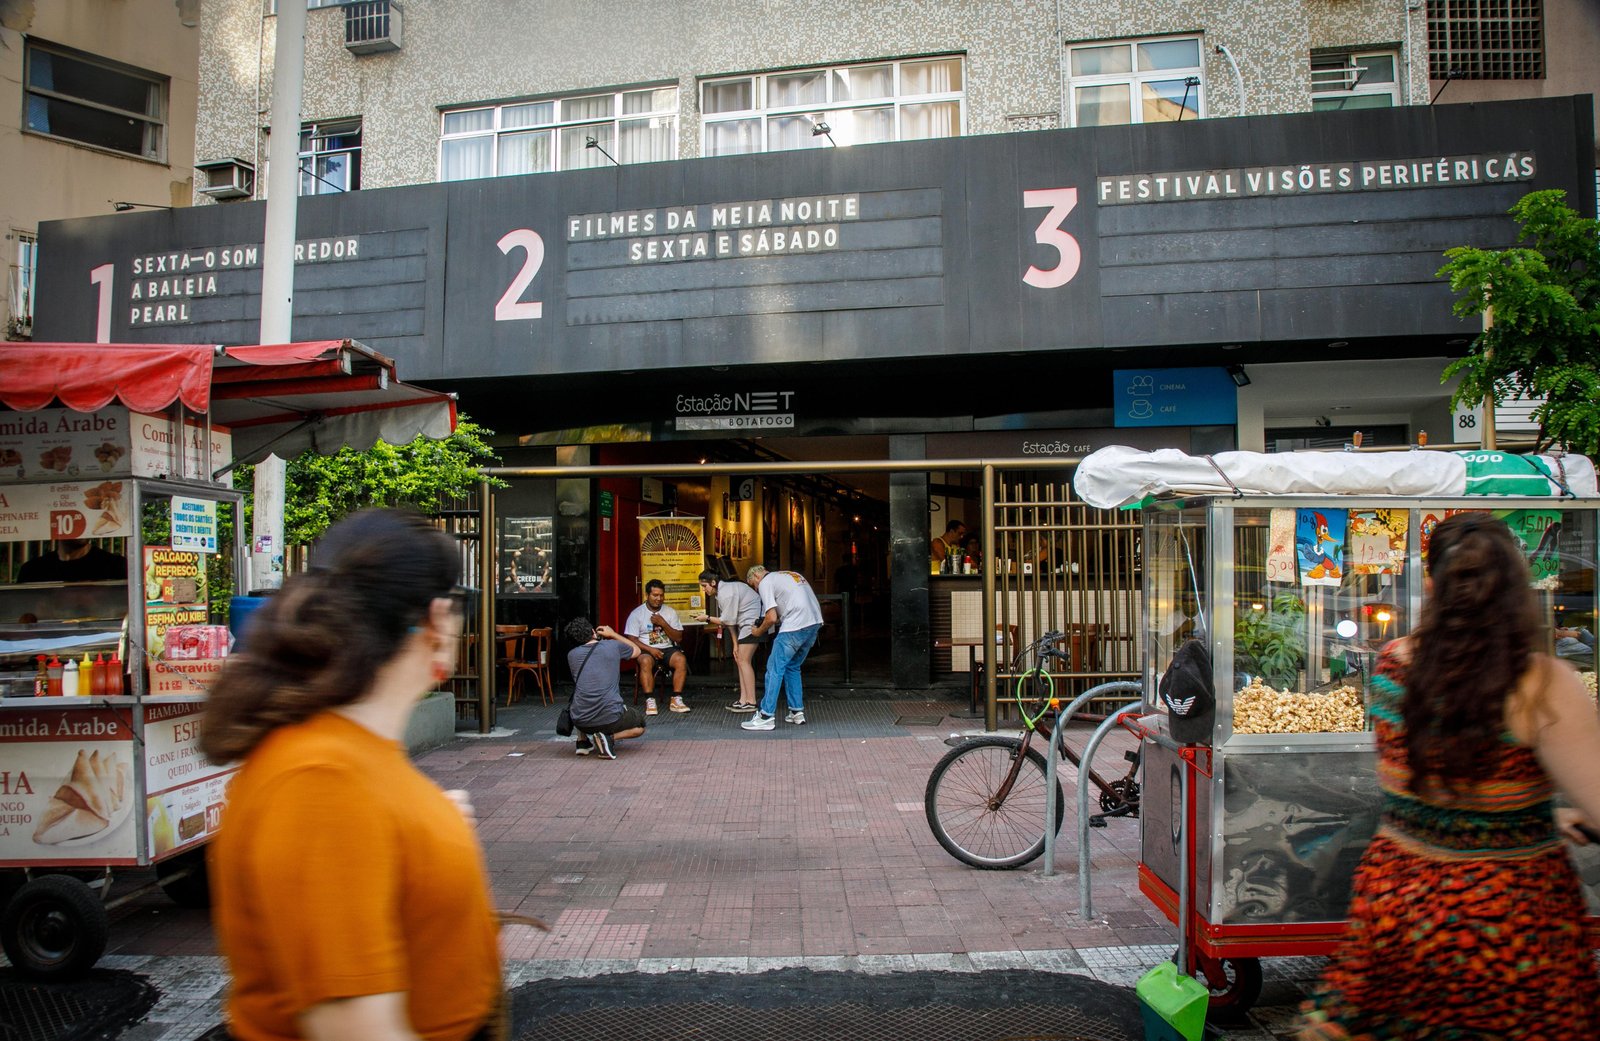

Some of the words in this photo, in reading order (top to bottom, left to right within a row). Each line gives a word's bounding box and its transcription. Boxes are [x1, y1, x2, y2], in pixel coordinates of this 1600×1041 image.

[1101, 174, 1237, 200] FESTIVAL
[1248, 165, 1351, 191] VISÕES
[570, 213, 655, 237] FILMES
[667, 210, 696, 230] DA
[713, 204, 771, 226] MEIA
[781, 198, 857, 221] NOITE
[631, 237, 706, 260] SEXTA
[718, 235, 729, 254] E
[741, 229, 837, 252] SÁBADO
[1022, 187, 1081, 289] 3
[221, 247, 258, 266] SOM
[495, 228, 545, 321] 2
[131, 282, 142, 299] A
[149, 276, 217, 298] BALEIA
[90, 263, 115, 344] 1
[131, 304, 189, 324] PEARL
[1159, 383, 1186, 391] CINEMA
[675, 393, 733, 415] Estação
[734, 391, 795, 412] NET
[55, 410, 117, 433] Árabe
[729, 416, 793, 427] BOTAFOGO
[1458, 414, 1476, 429] 88
[1022, 441, 1070, 455] Estação
[153, 550, 193, 563] SALGADO
[155, 565, 198, 576] REFRESCO
[148, 613, 176, 625] ESFIHA
[176, 612, 189, 622] OU
[189, 611, 206, 621] KIBE
[149, 703, 190, 720] HAMADA
[55, 712, 118, 736] Árabe
[149, 751, 176, 767] CARNE
[167, 762, 193, 780] QUEIJO
